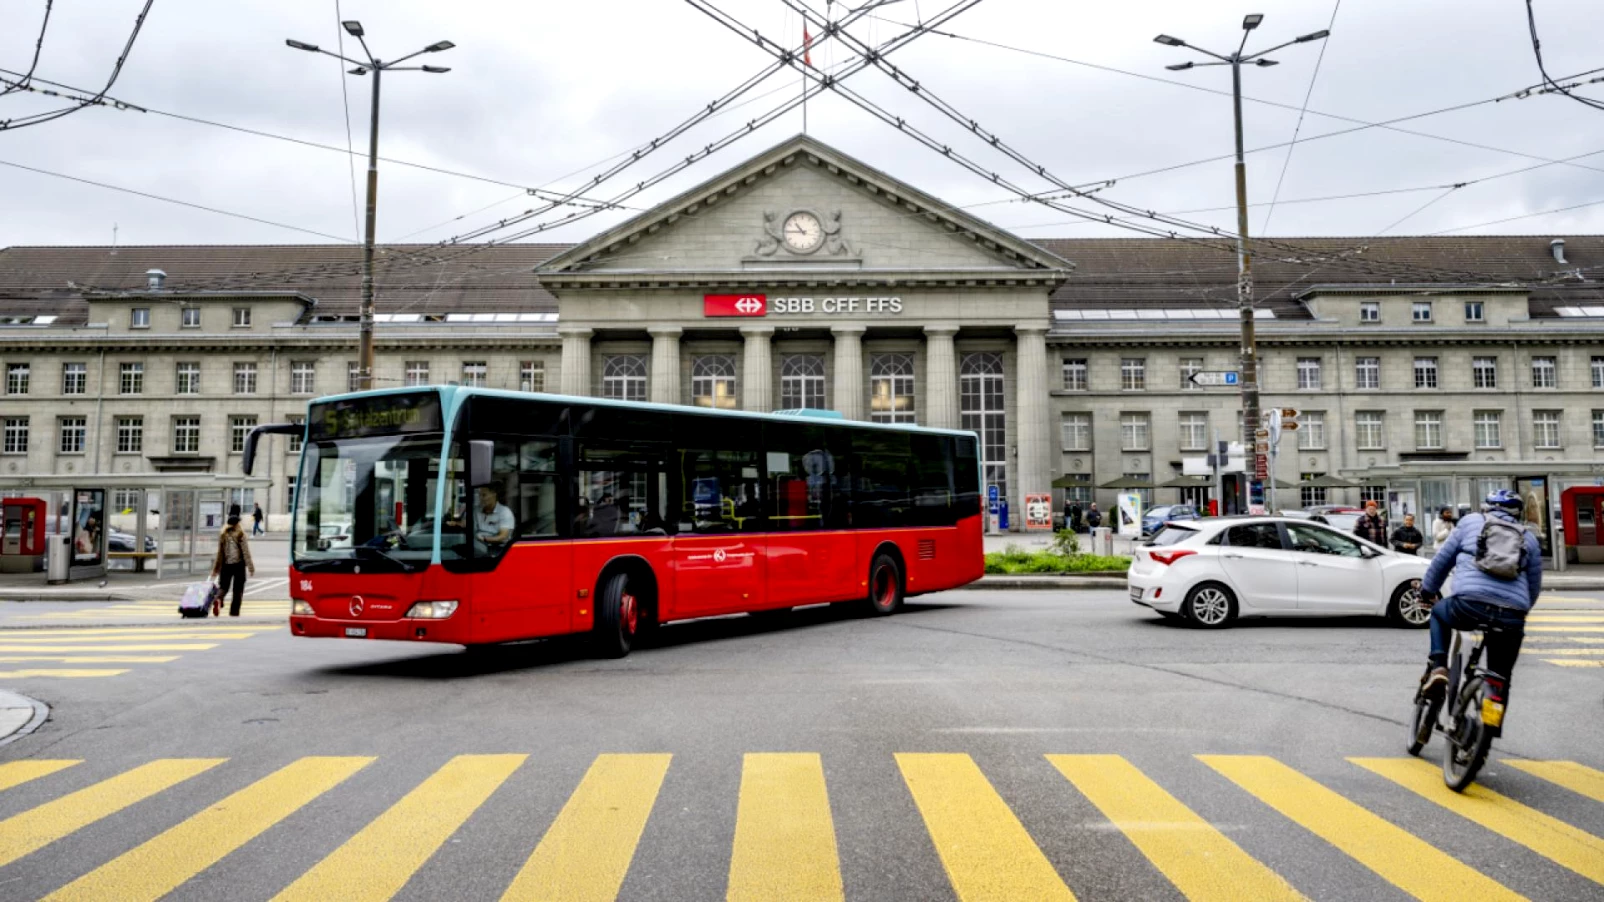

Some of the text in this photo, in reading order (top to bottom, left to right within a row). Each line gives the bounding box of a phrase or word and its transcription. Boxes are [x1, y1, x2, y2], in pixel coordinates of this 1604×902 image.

[773, 297, 903, 313] SBB CFF FFS
[325, 410, 338, 434] 5
[300, 579, 313, 591] 184
